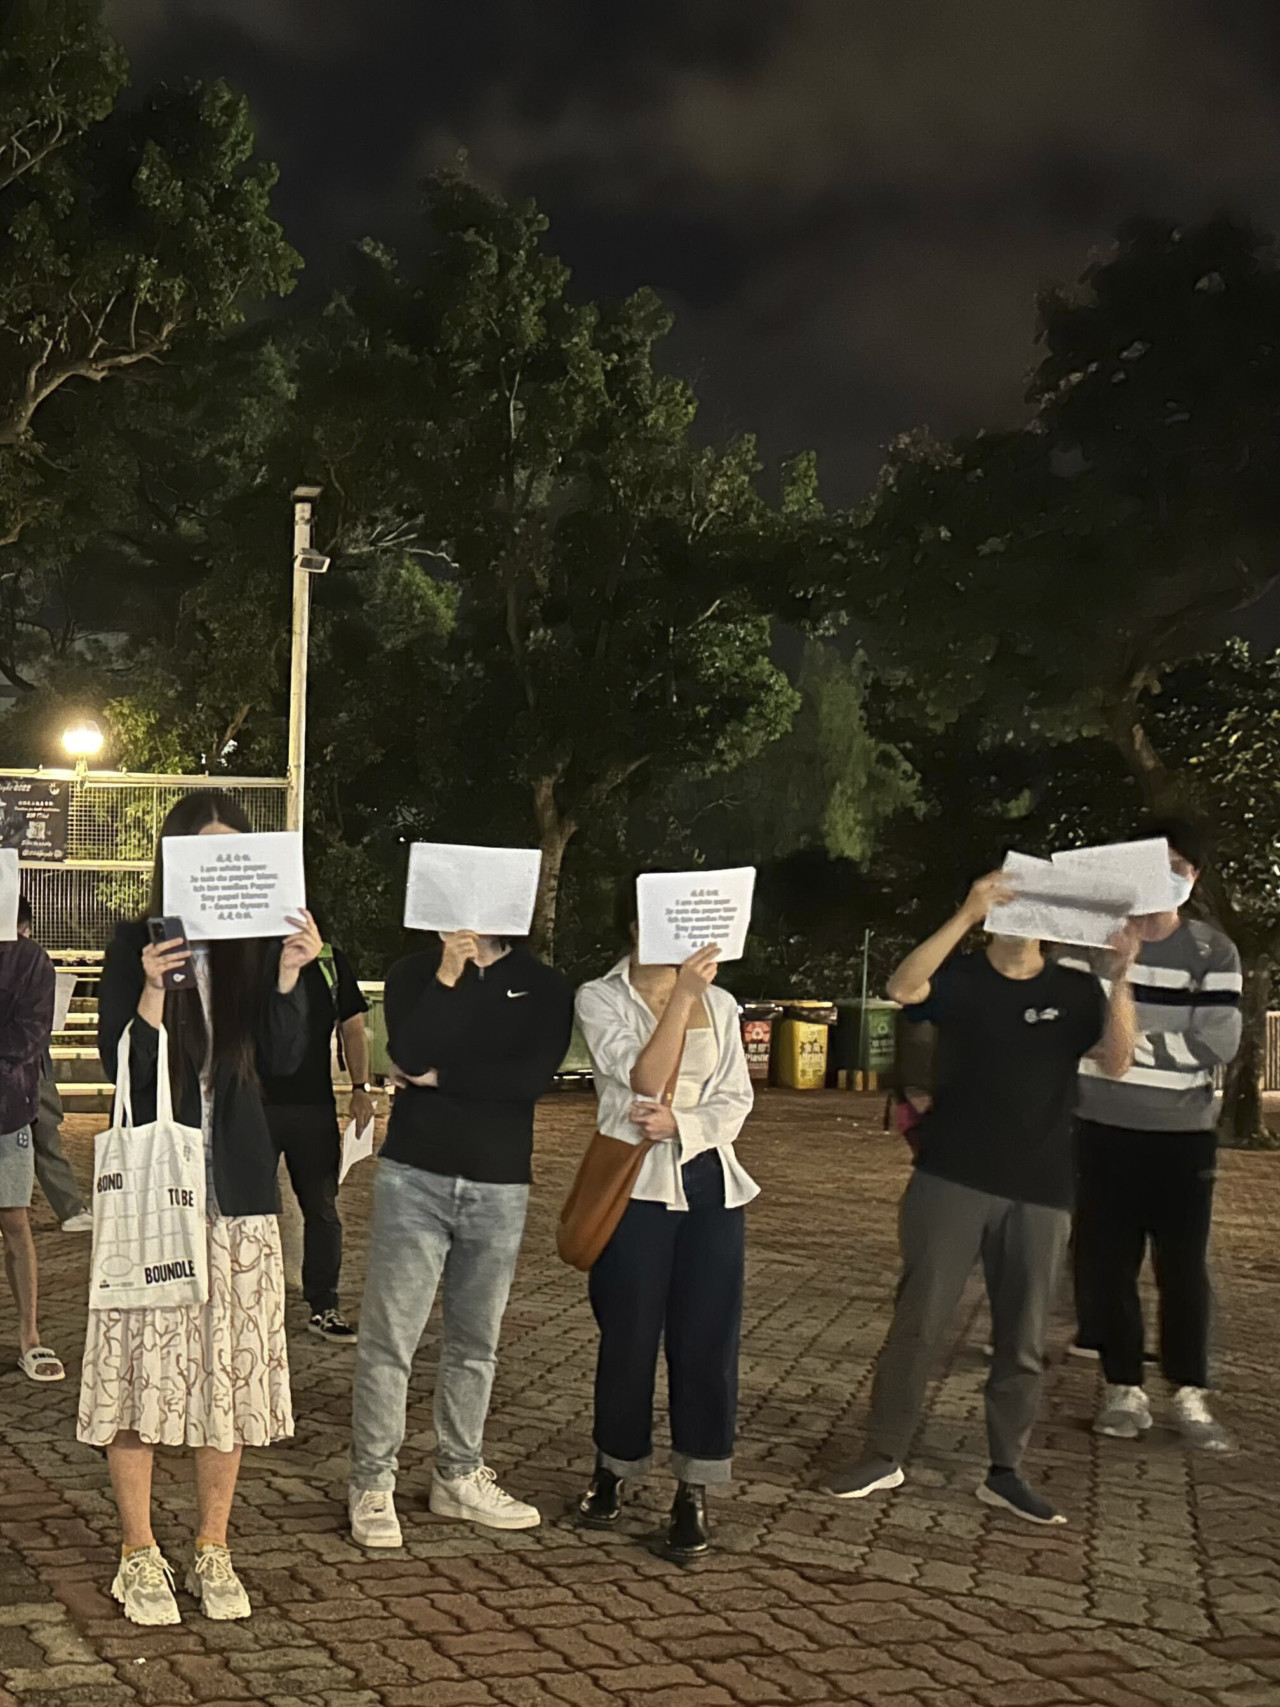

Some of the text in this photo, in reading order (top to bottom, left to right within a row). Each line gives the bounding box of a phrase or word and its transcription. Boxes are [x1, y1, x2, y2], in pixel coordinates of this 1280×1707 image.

[13, 782, 32, 792] 2022
[243, 864, 266, 872] paper
[181, 1190, 194, 1208] BE
[144, 1260, 196, 1285] BOUNDLE
